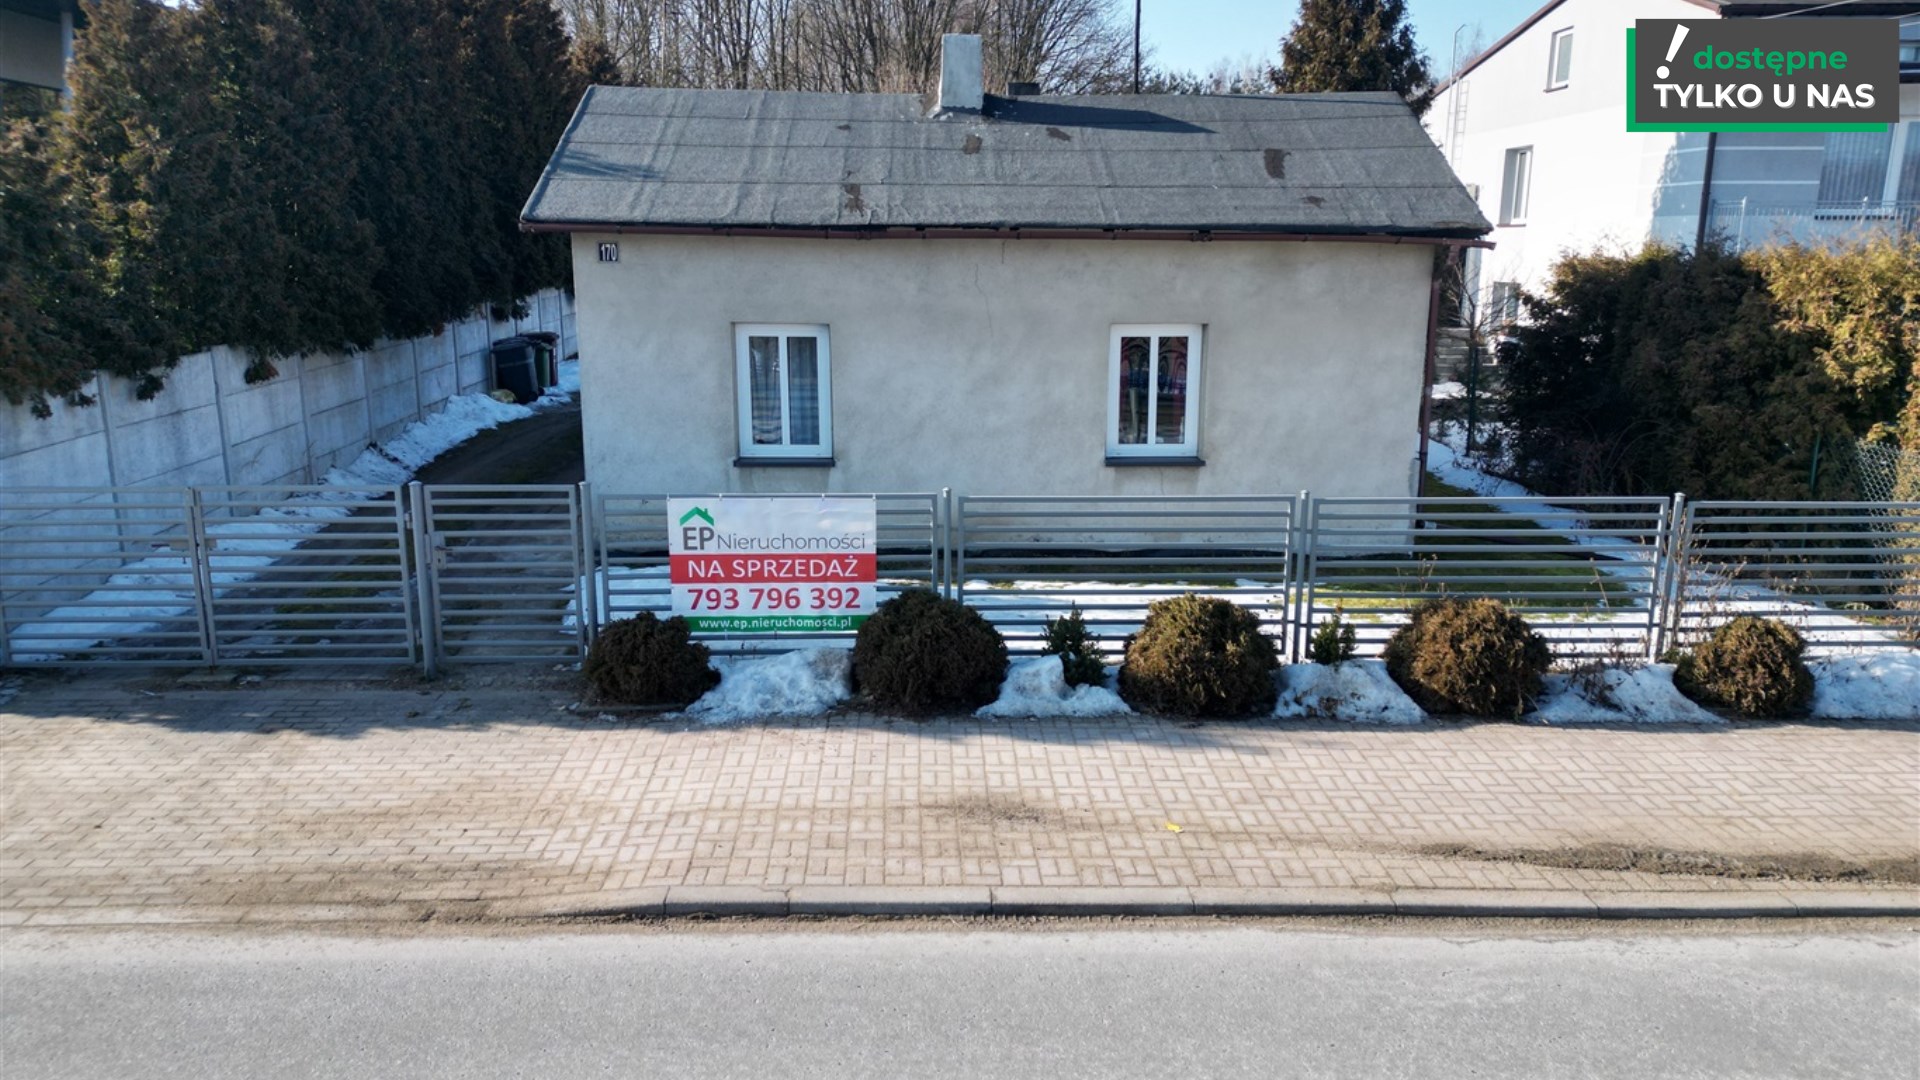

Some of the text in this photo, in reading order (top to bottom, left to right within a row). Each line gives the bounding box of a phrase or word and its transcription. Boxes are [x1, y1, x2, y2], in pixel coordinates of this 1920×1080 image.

[600, 243, 618, 260] 170
[682, 526, 865, 551] EP Nieruchomości
[688, 555, 859, 578] NA SPRZEDAŻ
[687, 587, 861, 610] 793 796 392
[699, 616, 852, 631] www.ep.nieruchomosci.pl
